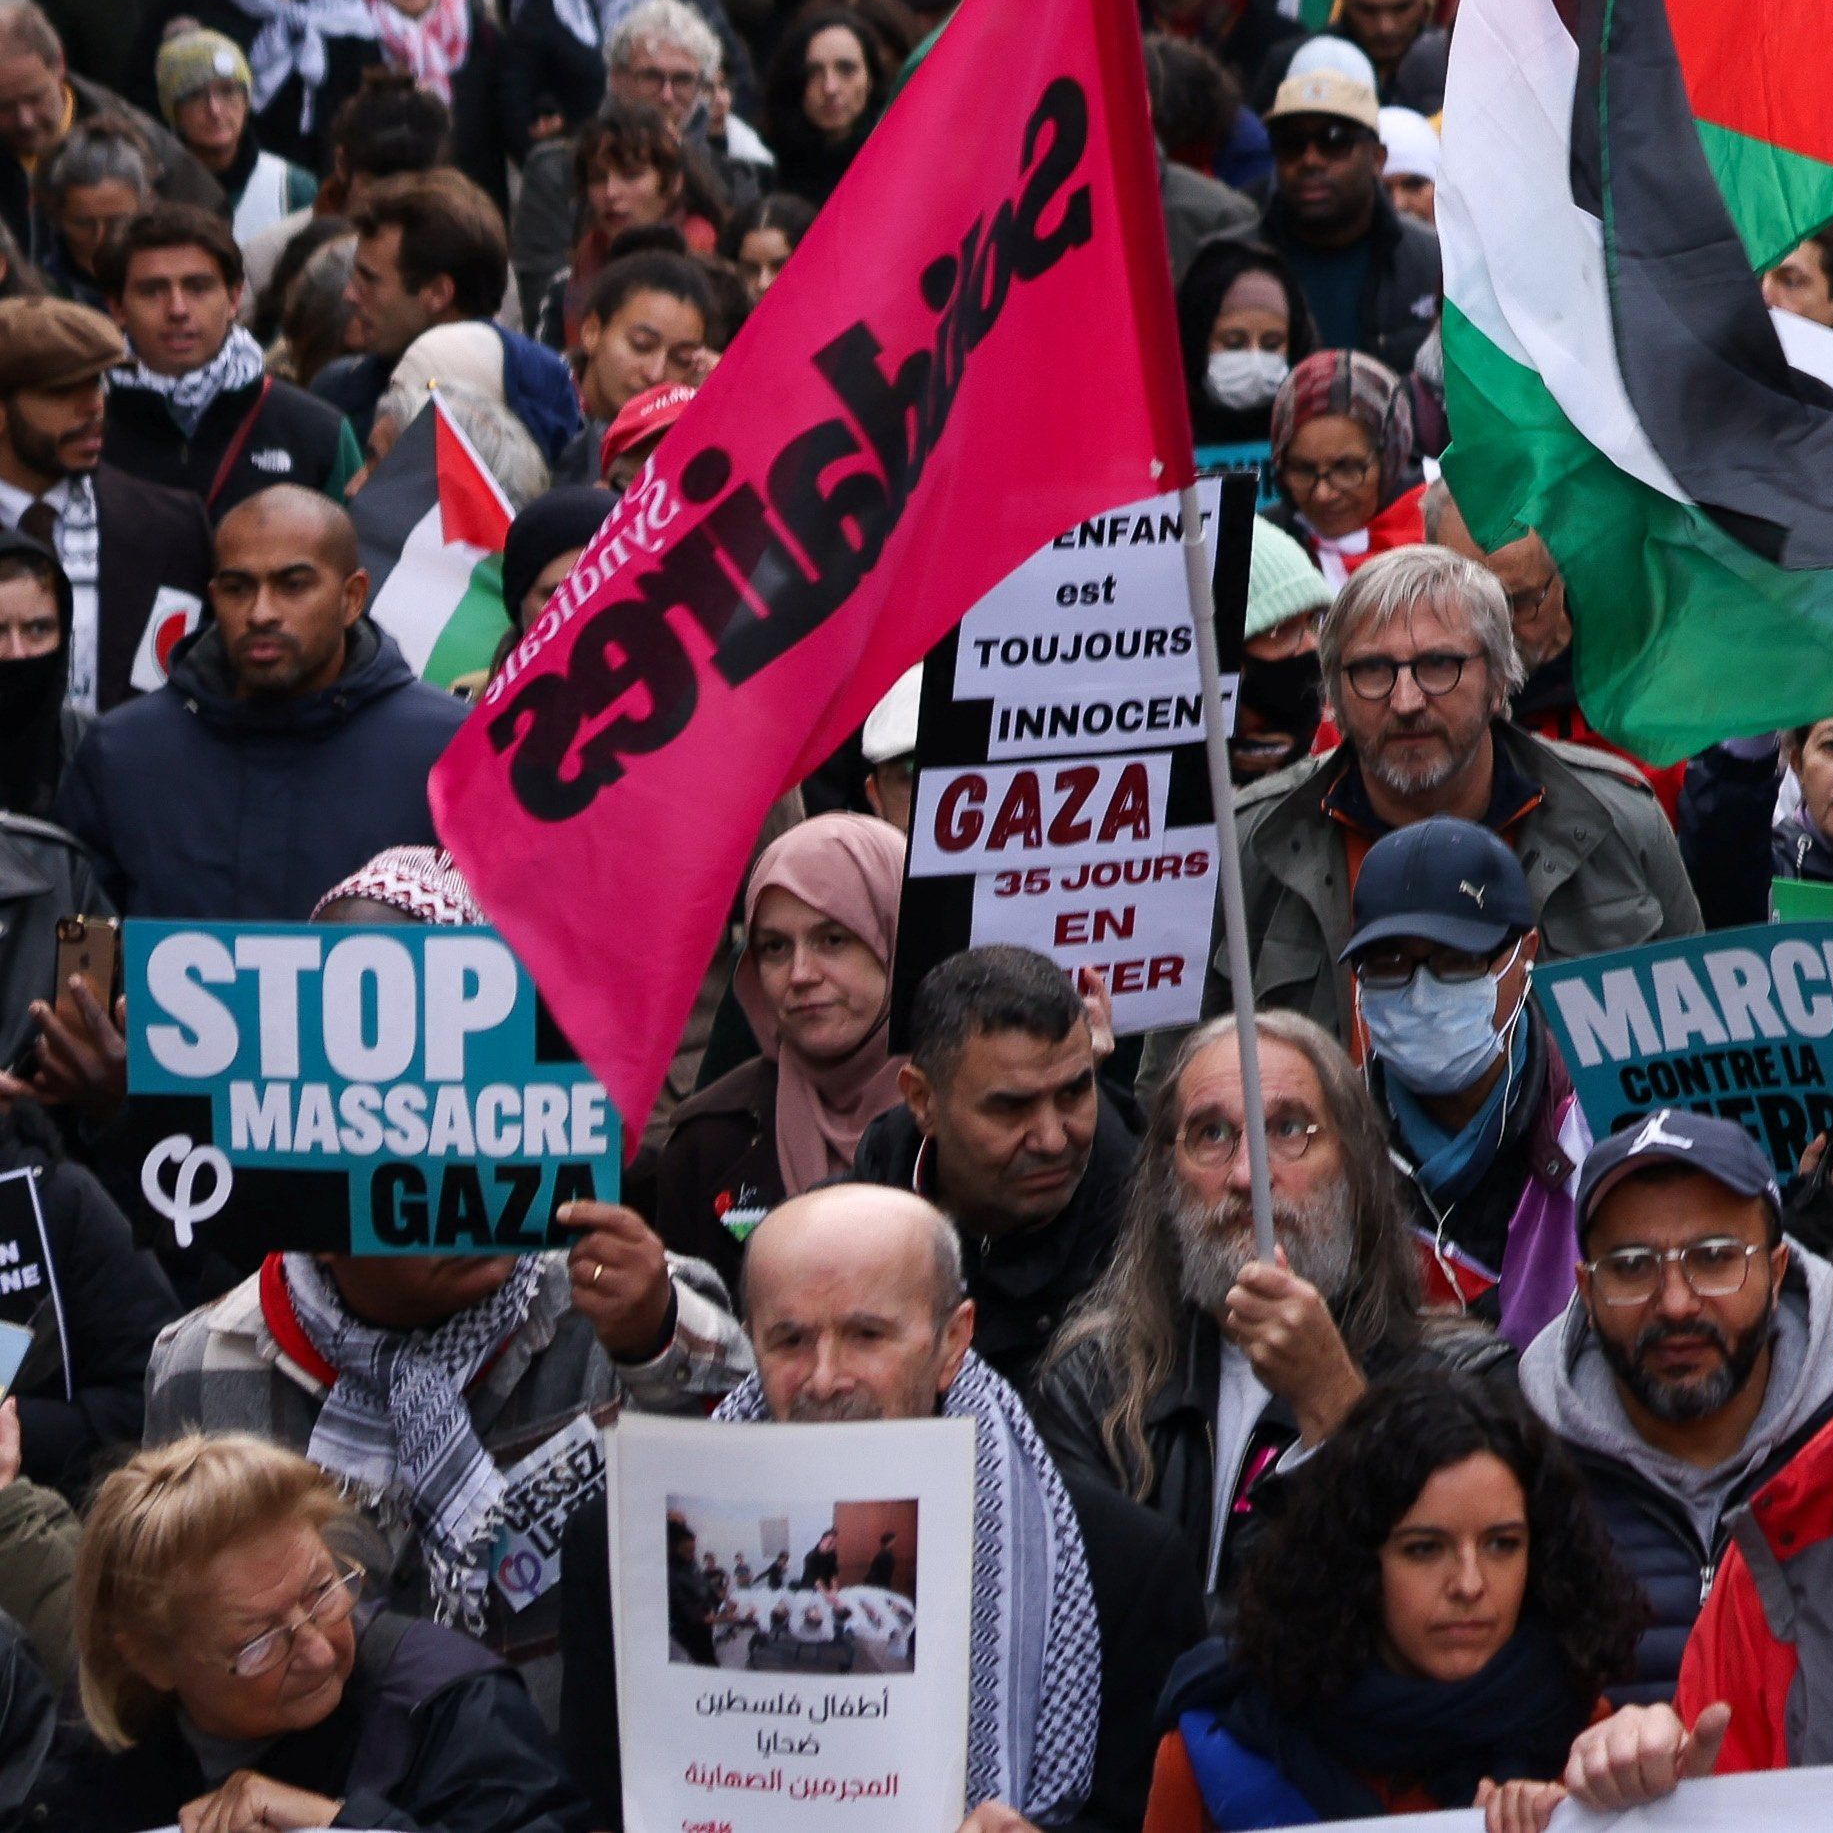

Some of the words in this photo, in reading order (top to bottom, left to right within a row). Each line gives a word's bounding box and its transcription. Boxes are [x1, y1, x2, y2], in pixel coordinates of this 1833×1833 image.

[1056, 574, 1117, 608] est
[973, 625, 1194, 670] TOUJOURS
[933, 761, 1151, 854] GAZA
[993, 869, 1052, 899] 35
[1059, 849, 1211, 892] JOURS
[1053, 905, 1136, 948] EN
[145, 929, 518, 1084] STOP
[1618, 1046, 1782, 1106] CONTRE
[1780, 1045, 1827, 1089] LA
[228, 1078, 607, 1159] MASSACRE
[368, 1161, 599, 1249] GAZA
[694, 1687, 802, 1718] فلسطين
[807, 1686, 889, 1725] أطفال
[755, 1729, 821, 1761] ضحايا
[684, 1761, 783, 1794] الصهاينة
[788, 1772, 899, 1803] المجرمين
